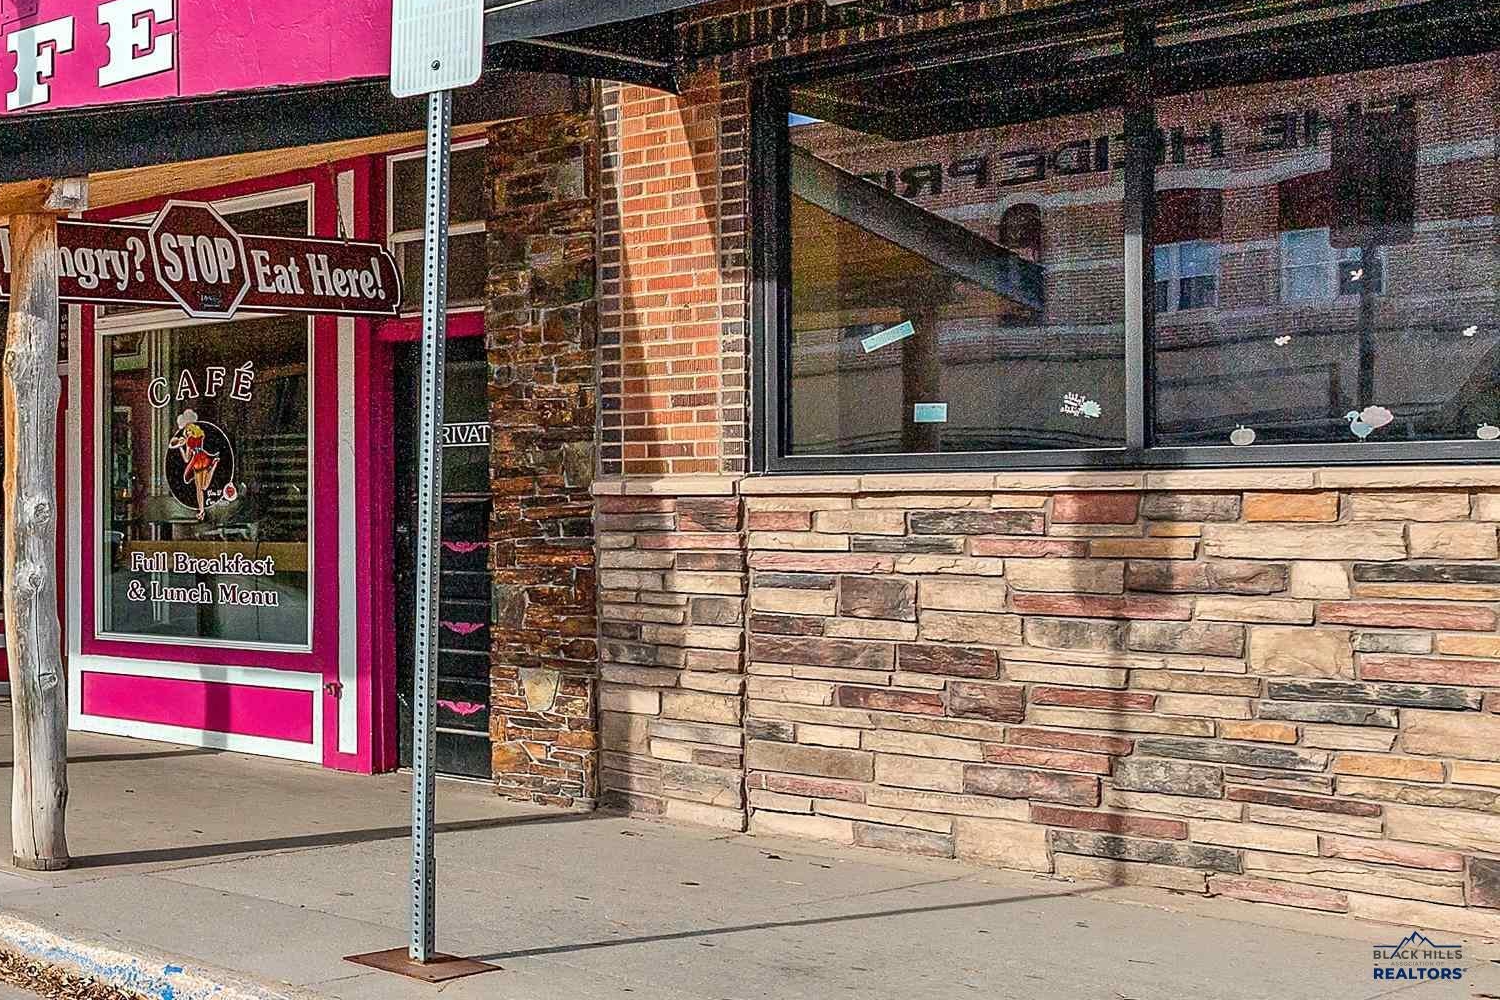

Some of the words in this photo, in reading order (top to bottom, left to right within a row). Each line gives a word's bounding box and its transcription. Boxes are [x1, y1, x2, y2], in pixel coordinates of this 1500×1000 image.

[159, 232, 237, 284] STOP
[250, 249, 303, 295] Eat
[306, 253, 387, 301] Here!
[147, 361, 255, 409] CAFÉ
[442, 424, 491, 444] RIVAT
[130, 551, 167, 572] Full
[173, 552, 275, 576] Breakfast
[126, 580, 147, 602] &
[150, 580, 213, 605] Lunch
[217, 583, 280, 608] Menu
